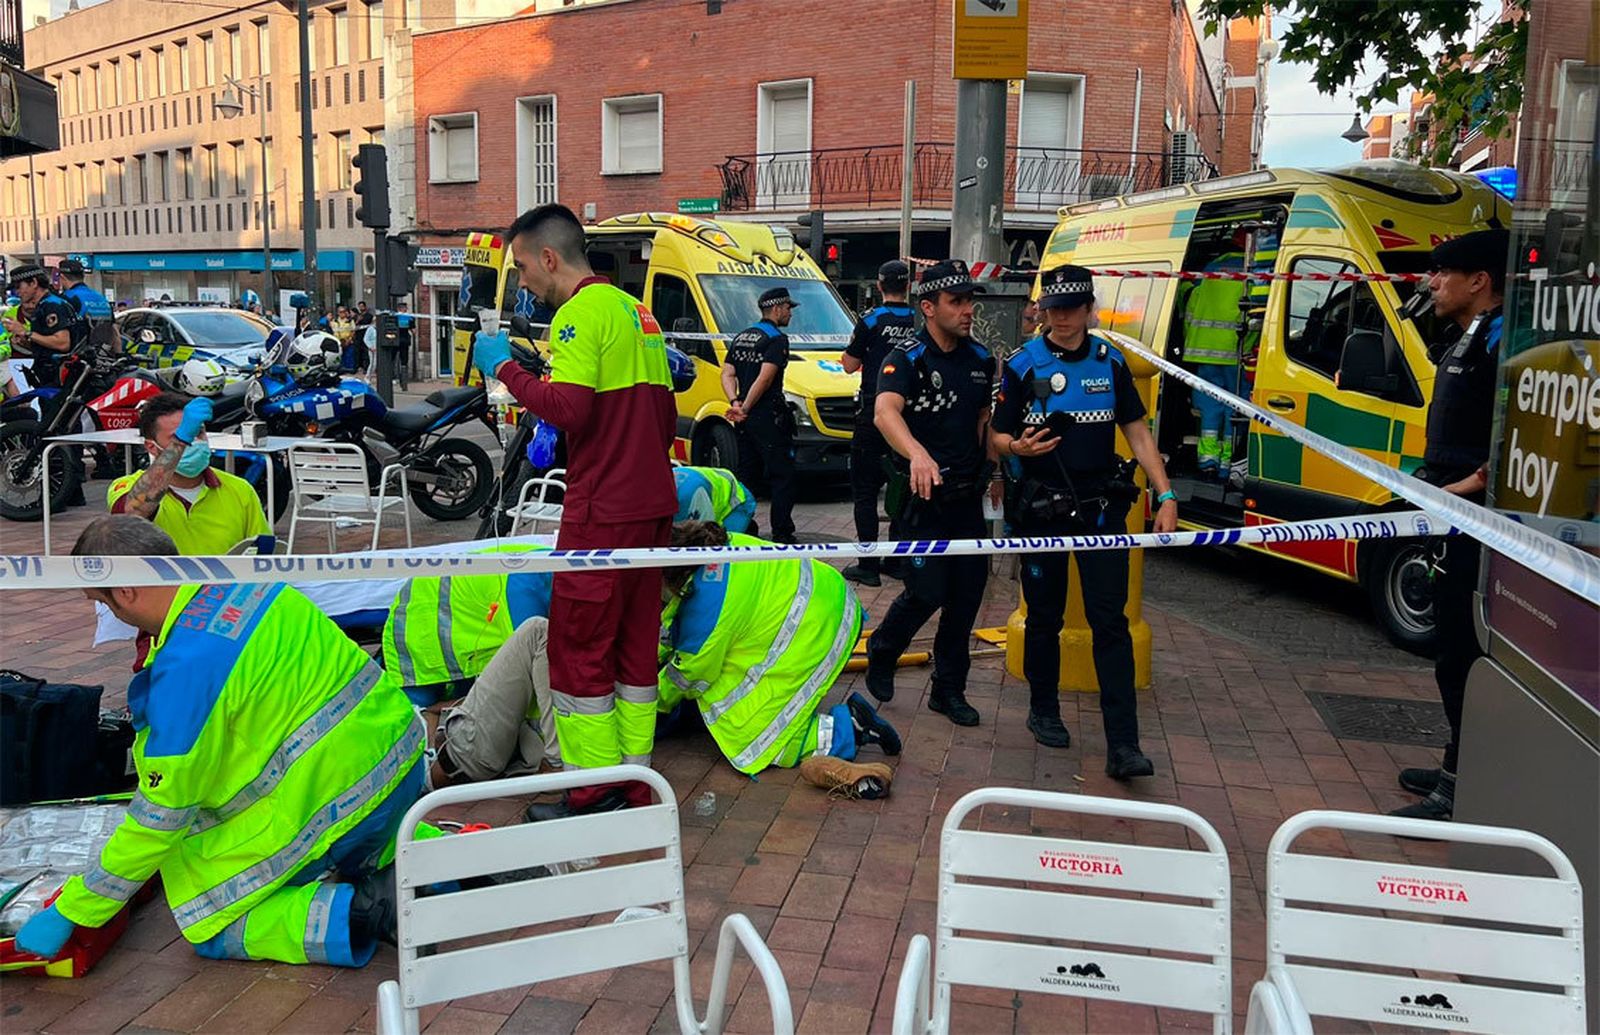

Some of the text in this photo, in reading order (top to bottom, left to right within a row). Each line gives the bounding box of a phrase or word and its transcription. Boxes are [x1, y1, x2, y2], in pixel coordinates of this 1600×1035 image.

[1529, 268, 1558, 331] Tu
[1507, 428, 1559, 519] hoy
[1040, 856, 1123, 876] VICTORIA
[1377, 882, 1468, 903] VICTORIA
[1040, 977, 1120, 993] VALDERRAMA MASTERS
[1383, 1007, 1470, 1024] VALDERRAMA MASTERS
